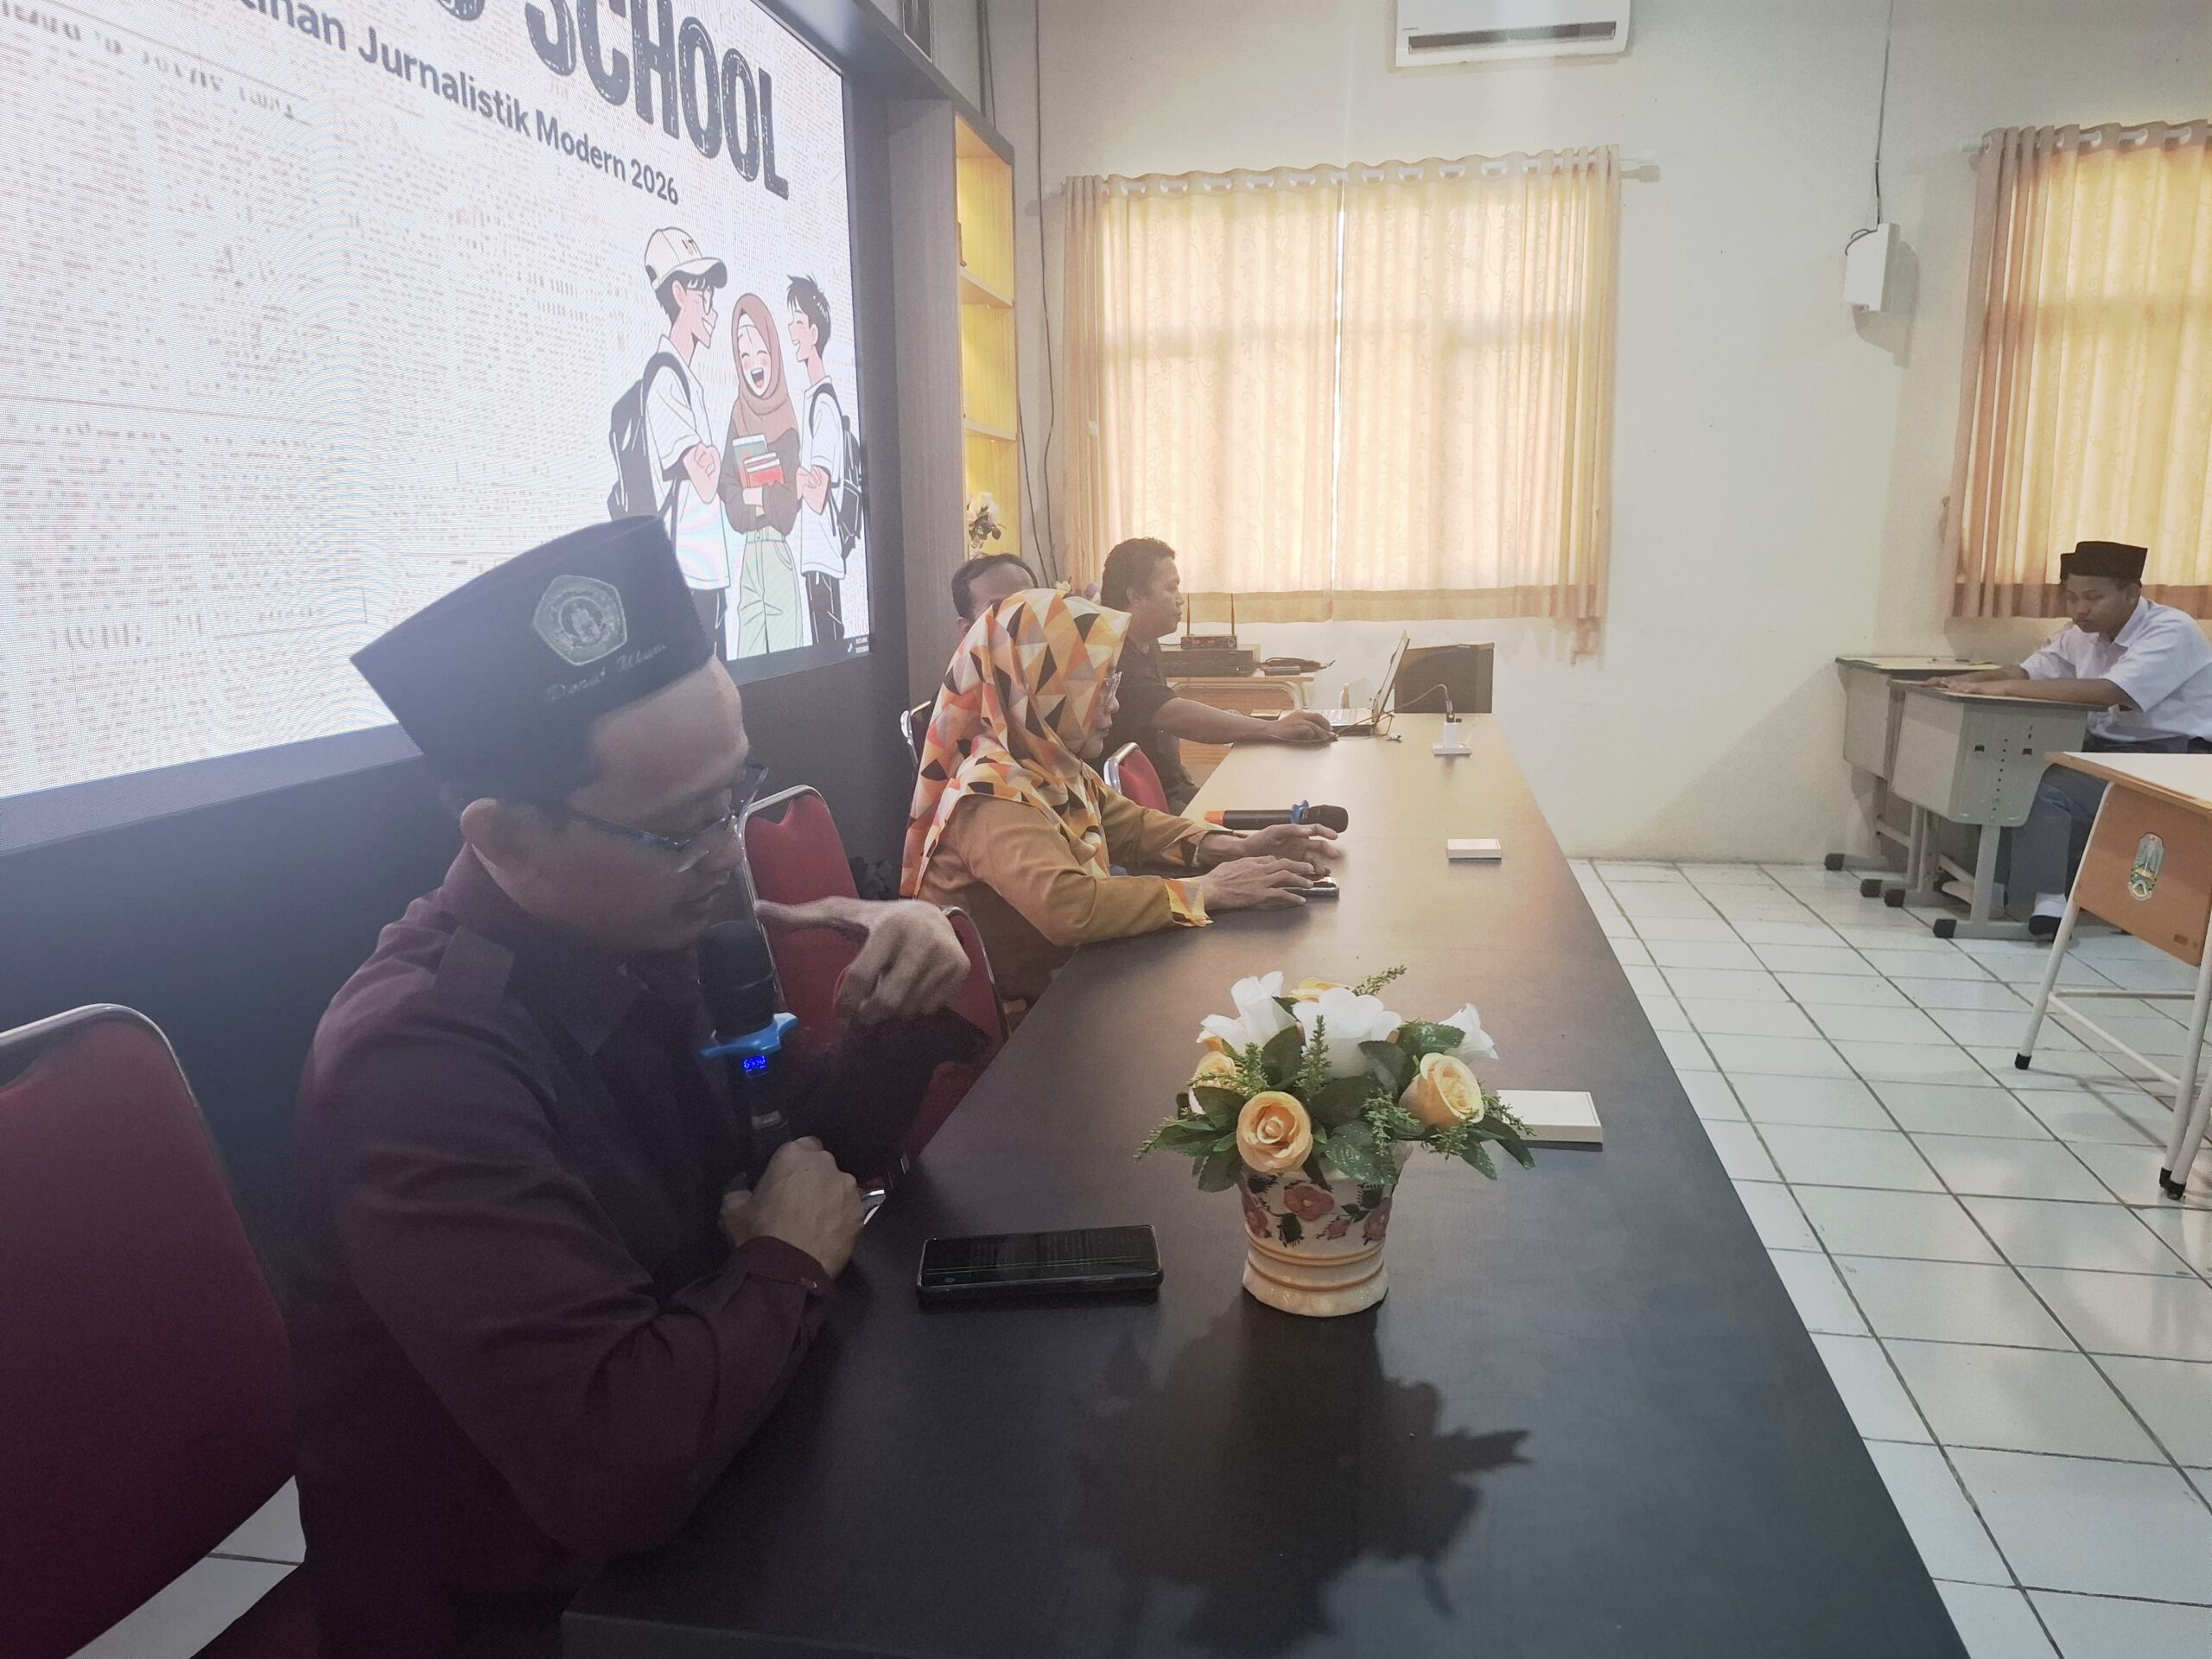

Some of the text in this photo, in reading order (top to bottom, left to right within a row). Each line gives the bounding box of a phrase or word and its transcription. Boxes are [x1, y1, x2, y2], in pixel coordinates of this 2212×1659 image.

[359, 26, 531, 137] Jurnalistik
[536, 109, 626, 181] Modern
[631, 158, 679, 206] 2026
